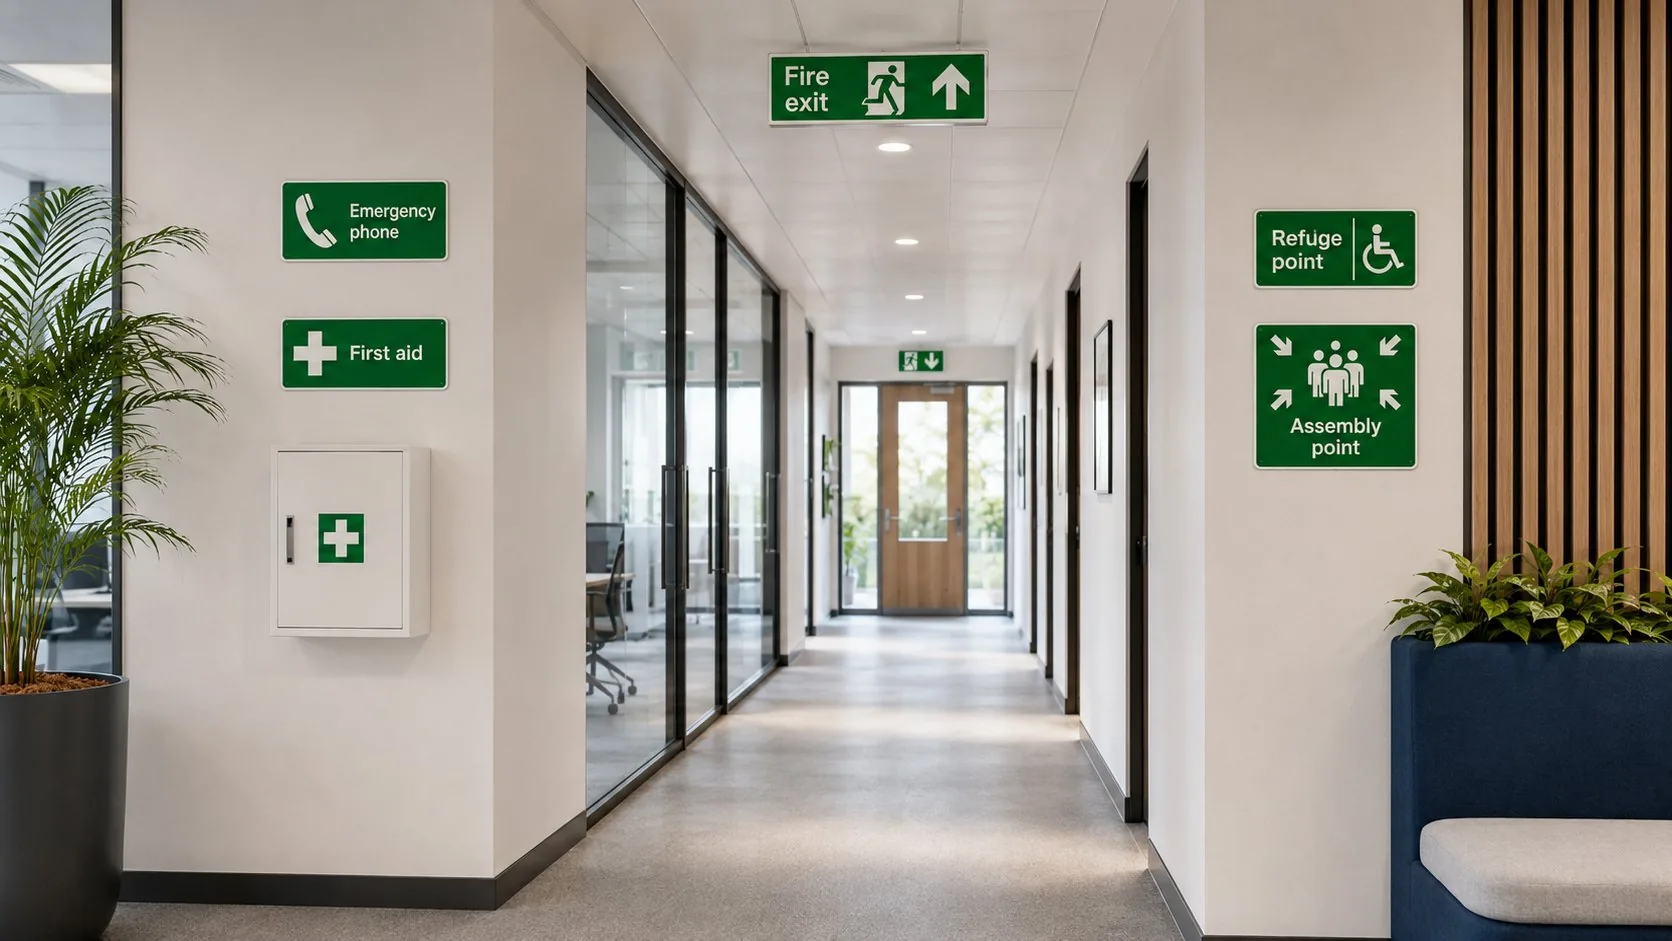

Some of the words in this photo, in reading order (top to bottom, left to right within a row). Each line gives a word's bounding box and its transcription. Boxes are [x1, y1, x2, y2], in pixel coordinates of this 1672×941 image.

[784, 65, 831, 87] Fire
[784, 90, 830, 113] exit
[349, 202, 438, 223] Emergency
[349, 224, 400, 241] phone
[1271, 252, 1325, 274] point
[349, 344, 391, 362] First
[394, 344, 424, 362] aid
[1289, 416, 1383, 439] Assembly
[1311, 439, 1361, 460] point
